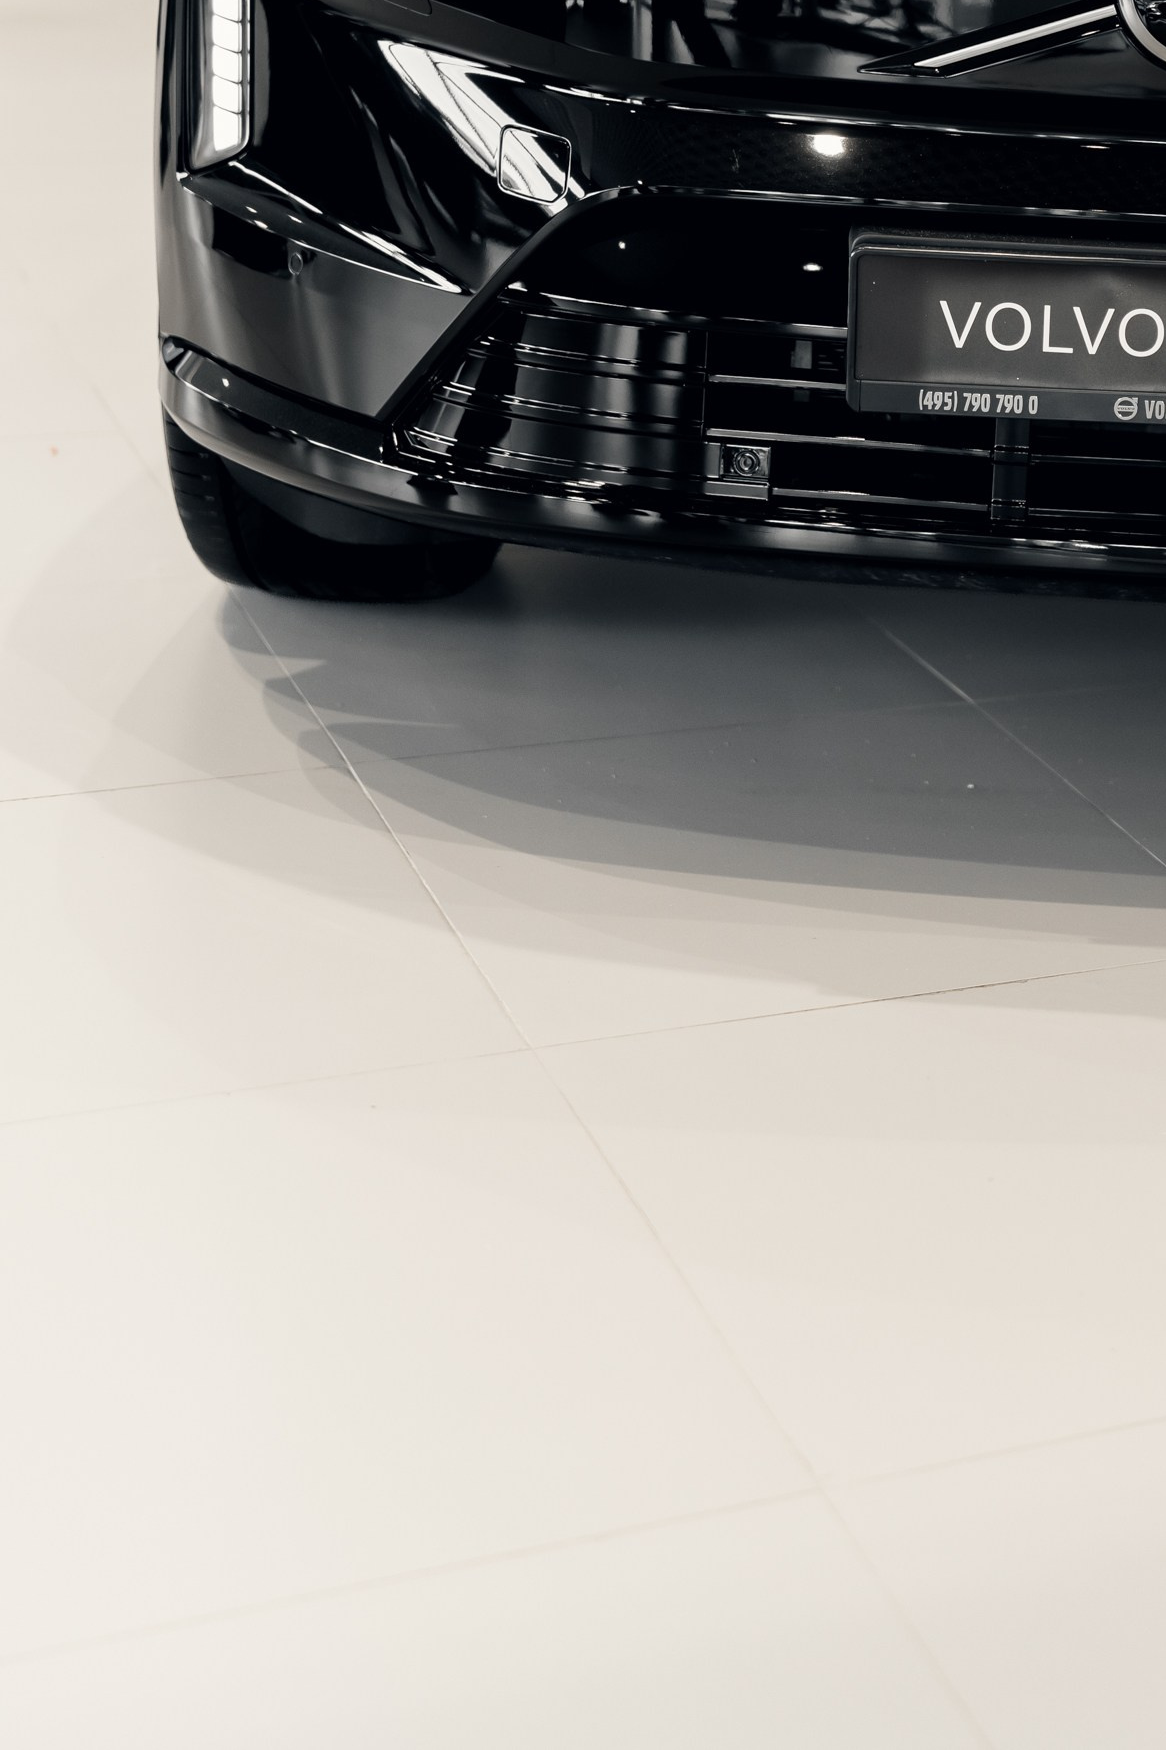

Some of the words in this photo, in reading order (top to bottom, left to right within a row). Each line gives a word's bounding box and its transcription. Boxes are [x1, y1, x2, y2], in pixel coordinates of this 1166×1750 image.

[939, 300, 1165, 358] VOLVO
[918, 389, 958, 412] (495)
[962, 392, 991, 413] 790
[995, 393, 1024, 414] 790
[1028, 395, 1039, 415] 0
